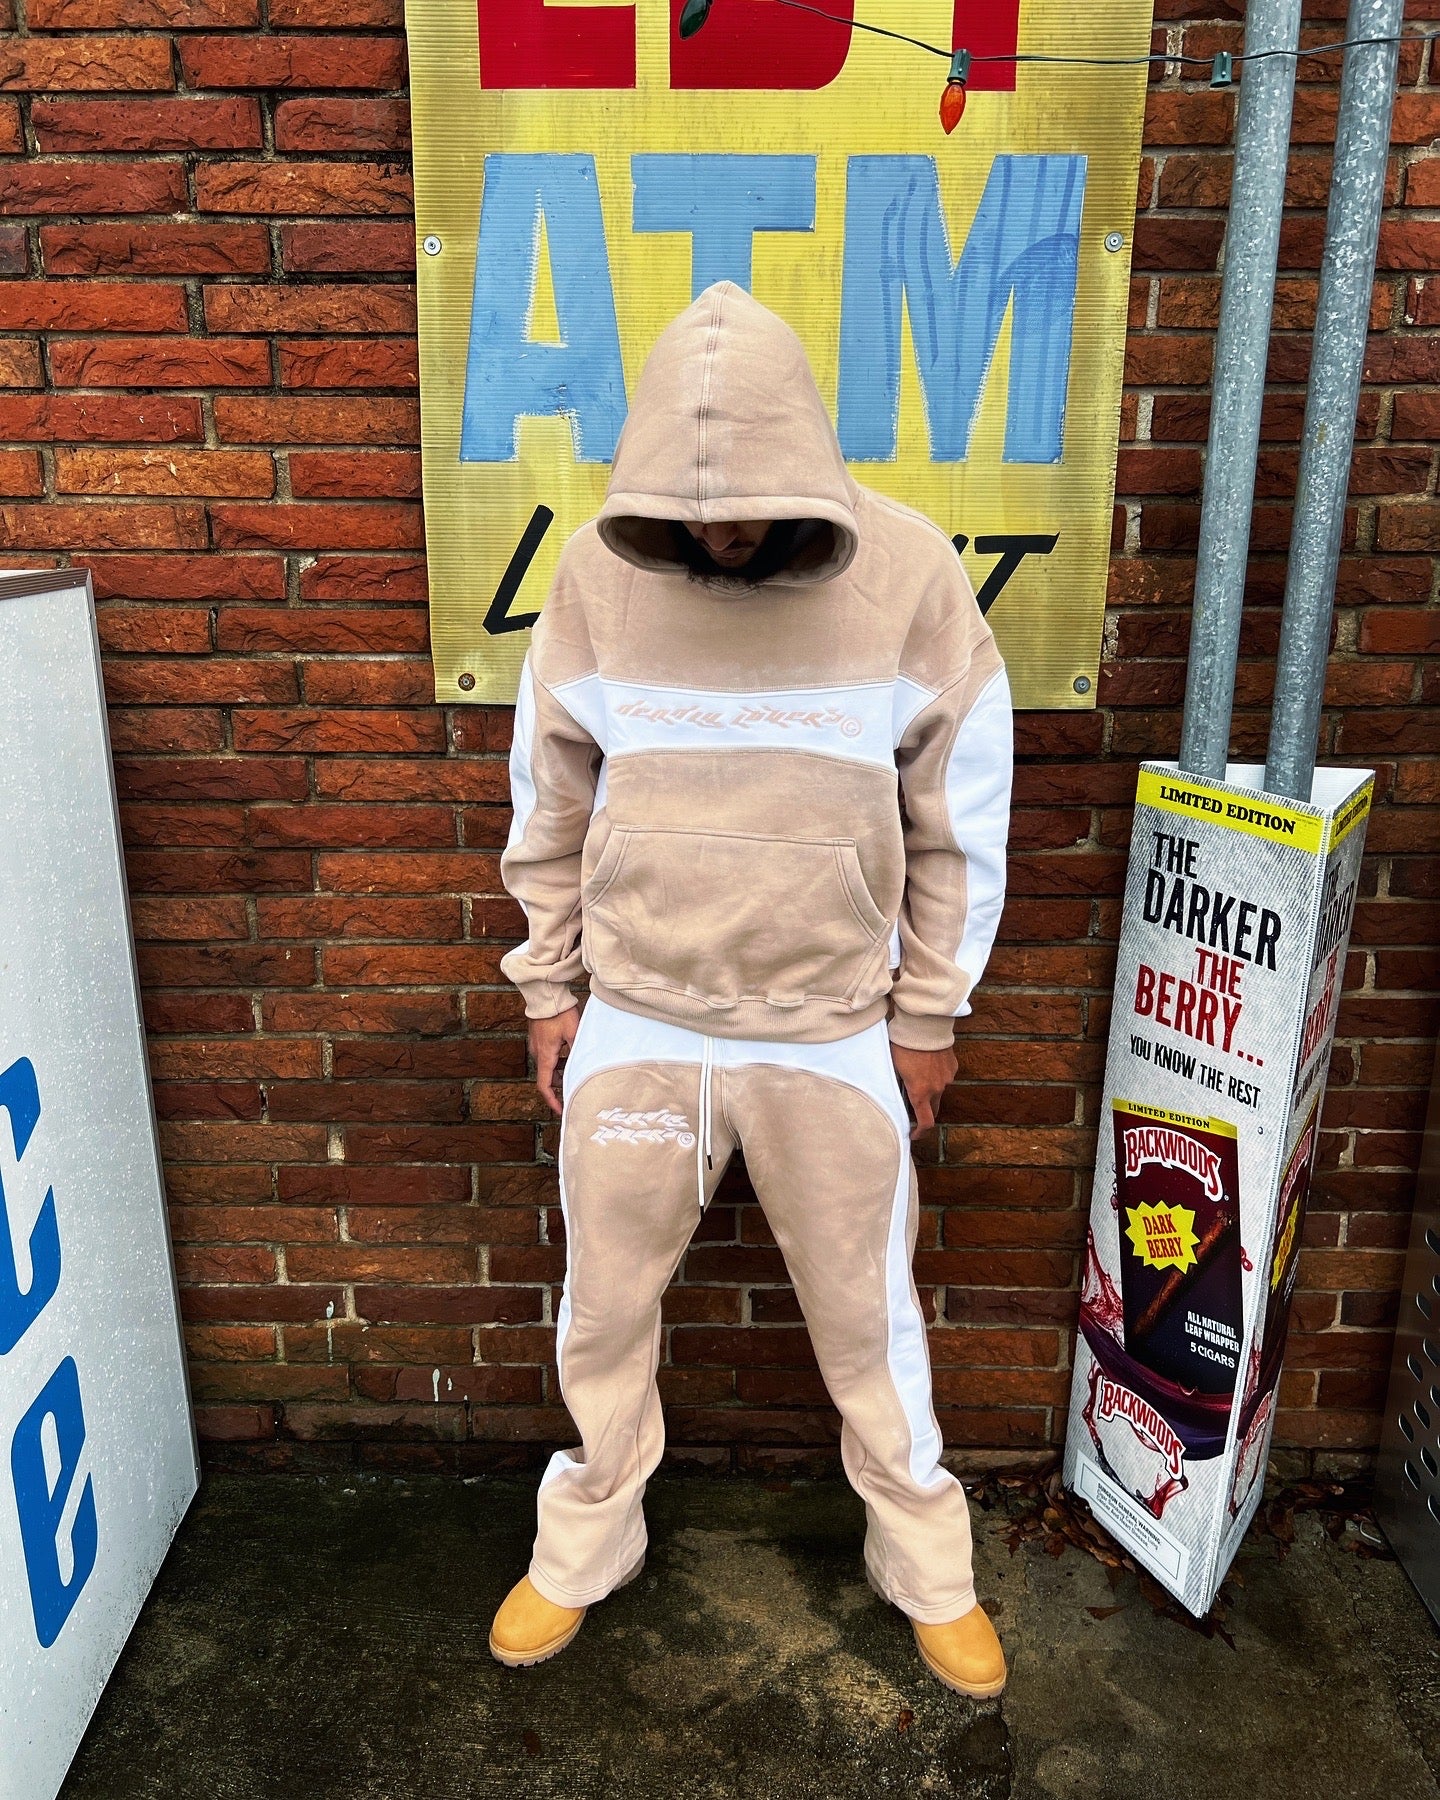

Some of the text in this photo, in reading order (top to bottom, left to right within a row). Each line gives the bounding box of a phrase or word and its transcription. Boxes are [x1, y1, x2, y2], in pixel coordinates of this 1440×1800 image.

[459, 153, 1088, 465] ATM
[1160, 786, 1223, 815] LIMITED
[1226, 804, 1297, 835] EDITION
[1152, 831, 1200, 879] THE
[1142, 869, 1282, 972] DARKER
[1195, 947, 1245, 1000] THE
[1134, 964, 1264, 1067] BERRY...
[1130, 1034, 1262, 1110] YOU KNOW THE REST
[1128, 1103, 1210, 1129] LIMITED EDITION
[1124, 1127, 1223, 1201] BACKWOODS
[1142, 1213, 1178, 1236] DARK
[1146, 1236, 1184, 1259] BERRY
[1185, 1321, 1240, 1353] LEAF WRAPPER
[1187, 1311, 1237, 1339] ALL NATURAL
[1190, 1341, 1235, 1368] 5 CIGARS
[1099, 1380, 1186, 1478] BACKWOODS
